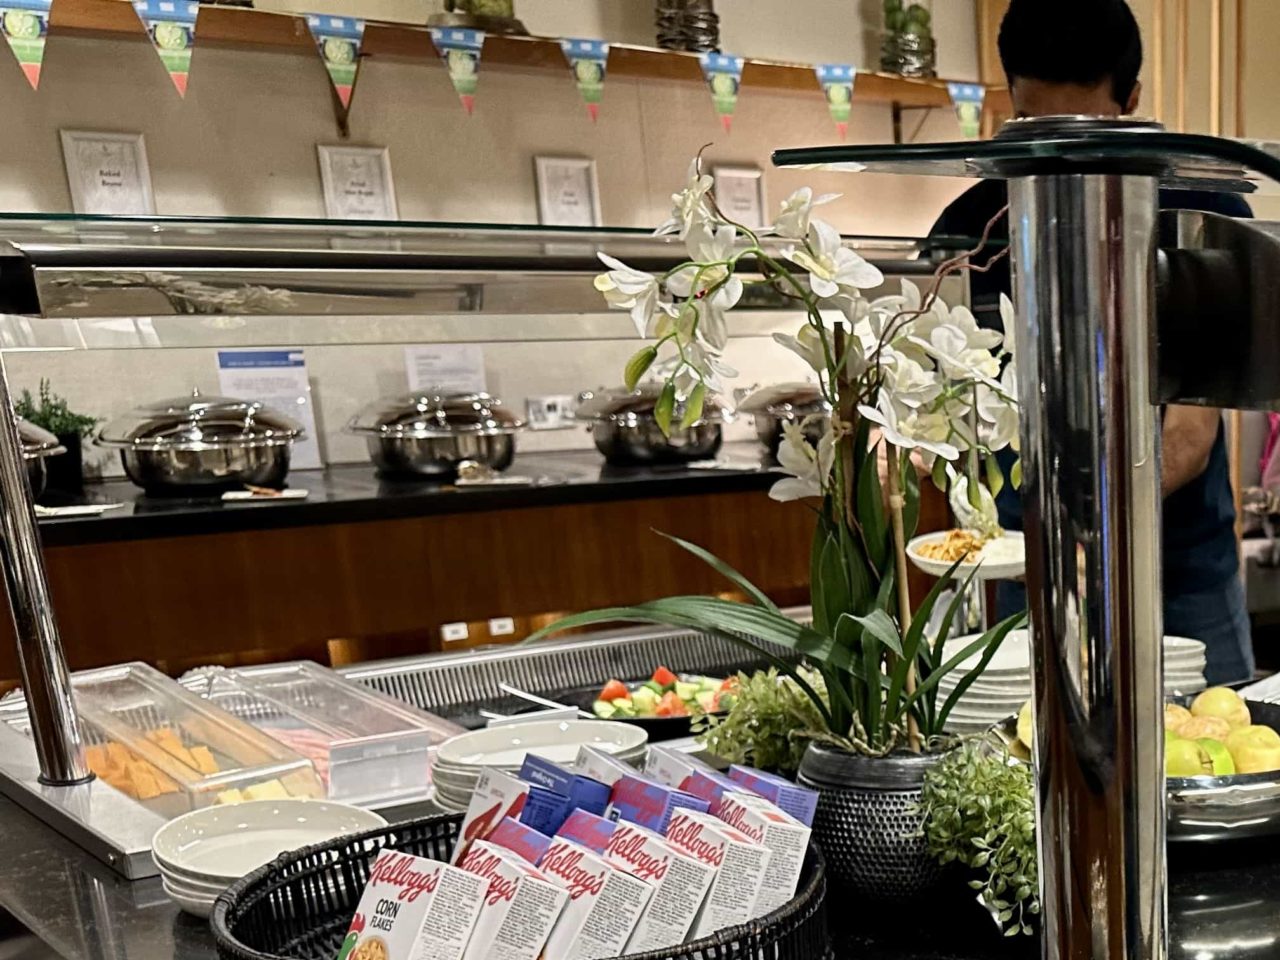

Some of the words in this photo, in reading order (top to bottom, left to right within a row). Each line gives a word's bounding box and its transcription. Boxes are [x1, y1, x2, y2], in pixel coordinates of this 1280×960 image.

[607, 827, 668, 880] Kellogg's
[667, 814, 725, 869] Kellogg's
[368, 853, 440, 902] Kellogg's
[538, 844, 605, 900] Kellogg's
[370, 915, 395, 932] FLAKES
[375, 898, 400, 918] CORN
